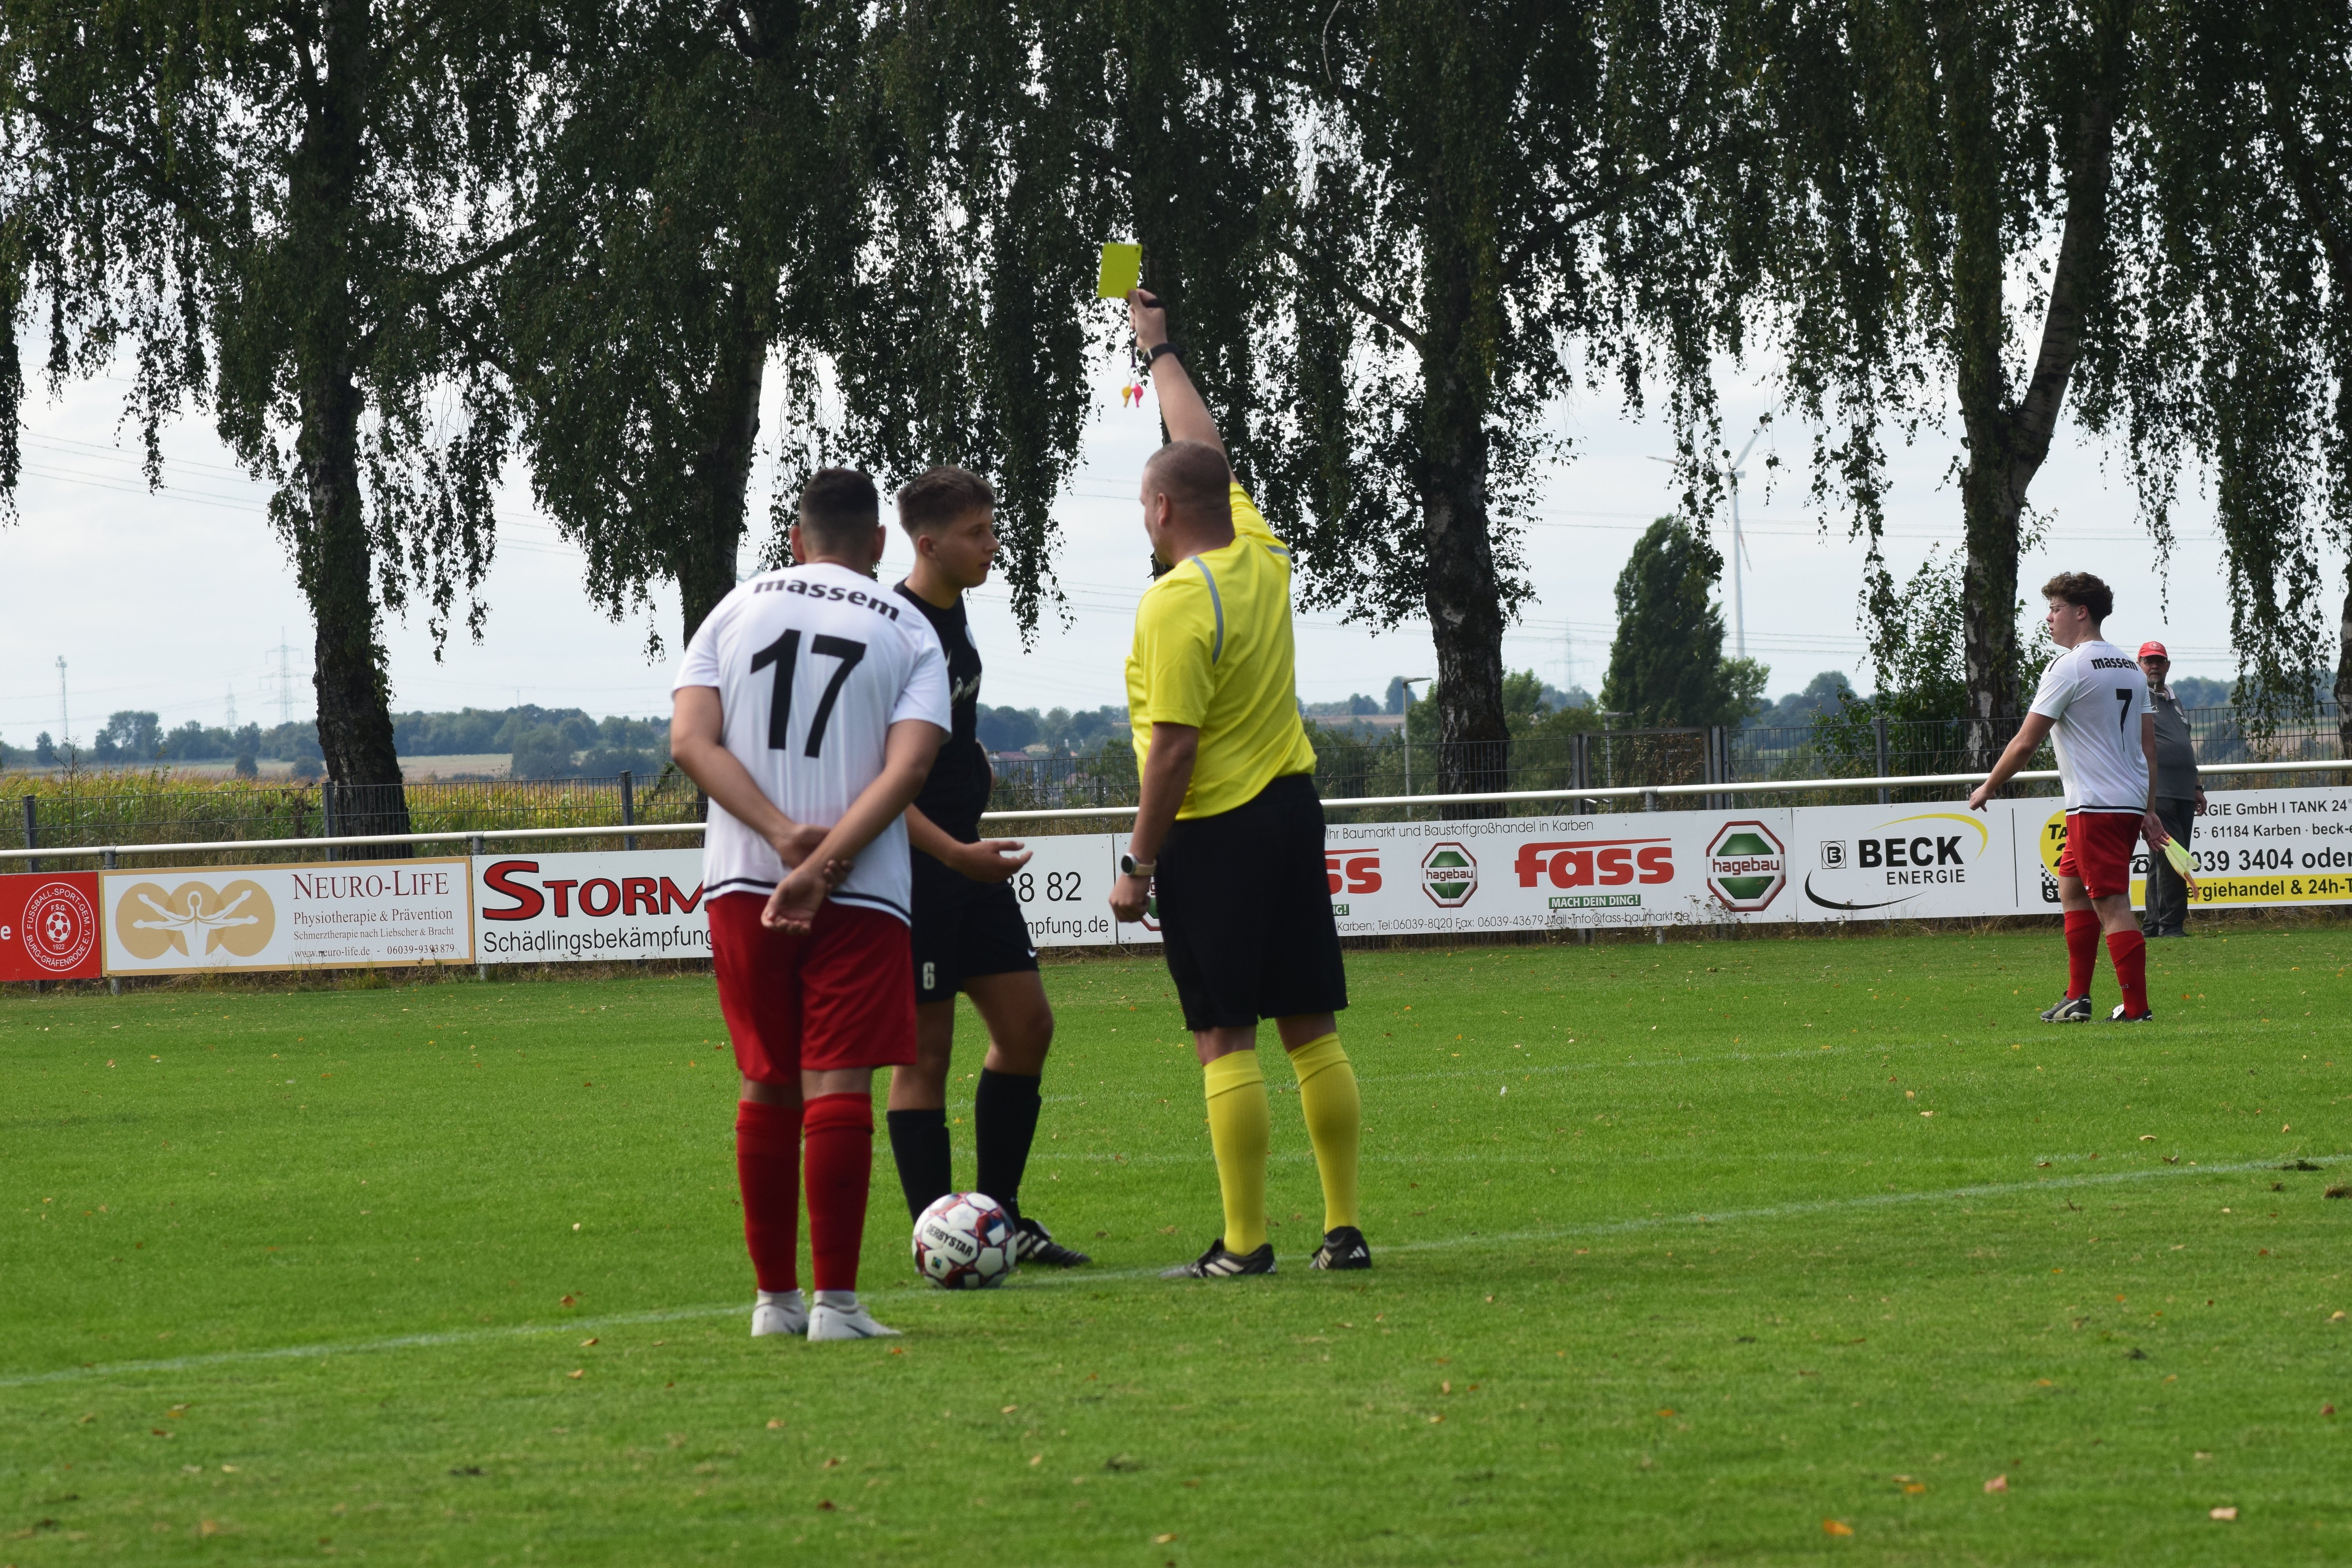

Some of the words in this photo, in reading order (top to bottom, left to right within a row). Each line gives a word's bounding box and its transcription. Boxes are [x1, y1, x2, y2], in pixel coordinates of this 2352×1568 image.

[753, 579, 900, 621] massem
[2091, 657, 2139, 671] massem
[750, 628, 867, 759] 17
[2116, 688, 2133, 752] 7
[2236, 802, 2277, 815] GmbH
[2290, 800, 2328, 813] TANK
[1327, 828, 1339, 840] Ihr
[1343, 826, 1396, 839] Baumarkt
[1399, 825, 1421, 837] und
[1425, 821, 1535, 838] Baustoffgroßhandel
[1540, 820, 1549, 832] in
[1553, 819, 1594, 832] Karben
[2048, 824, 2068, 840] TA
[2211, 825, 2249, 838] 61184
[2253, 824, 2301, 837] Karben
[1858, 835, 1964, 868] BECK
[2238, 848, 2294, 871] 3404
[1514, 838, 1675, 889] fass
[1712, 857, 1780, 876] hagebau
[1426, 868, 1474, 882] hagebau
[1887, 868, 1965, 886] ENERGIE
[1047, 871, 1082, 902] 82
[2290, 879, 2303, 895] &
[1551, 897, 1582, 908] MACH
[1583, 896, 1607, 907] DEIN
[1609, 895, 1639, 906] DING!
[293, 909, 377, 927] Physiotherapie
[379, 911, 388, 922] &
[392, 907, 453, 922] Prävention
[1455, 917, 1475, 928] Fax:
[1477, 914, 1544, 927] 06039-43679
[1573, 910, 1690, 926] info@fass-baumarkt.de
[294, 929, 358, 941] Schmerztherapie
[360, 928, 378, 938] nach
[380, 927, 418, 937] Liebscher
[420, 927, 426, 936] &
[428, 926, 454, 936] Bracht
[294, 946, 370, 958] www.neuro-life.de
[926, 1224, 973, 1257] DERBYSTAR
